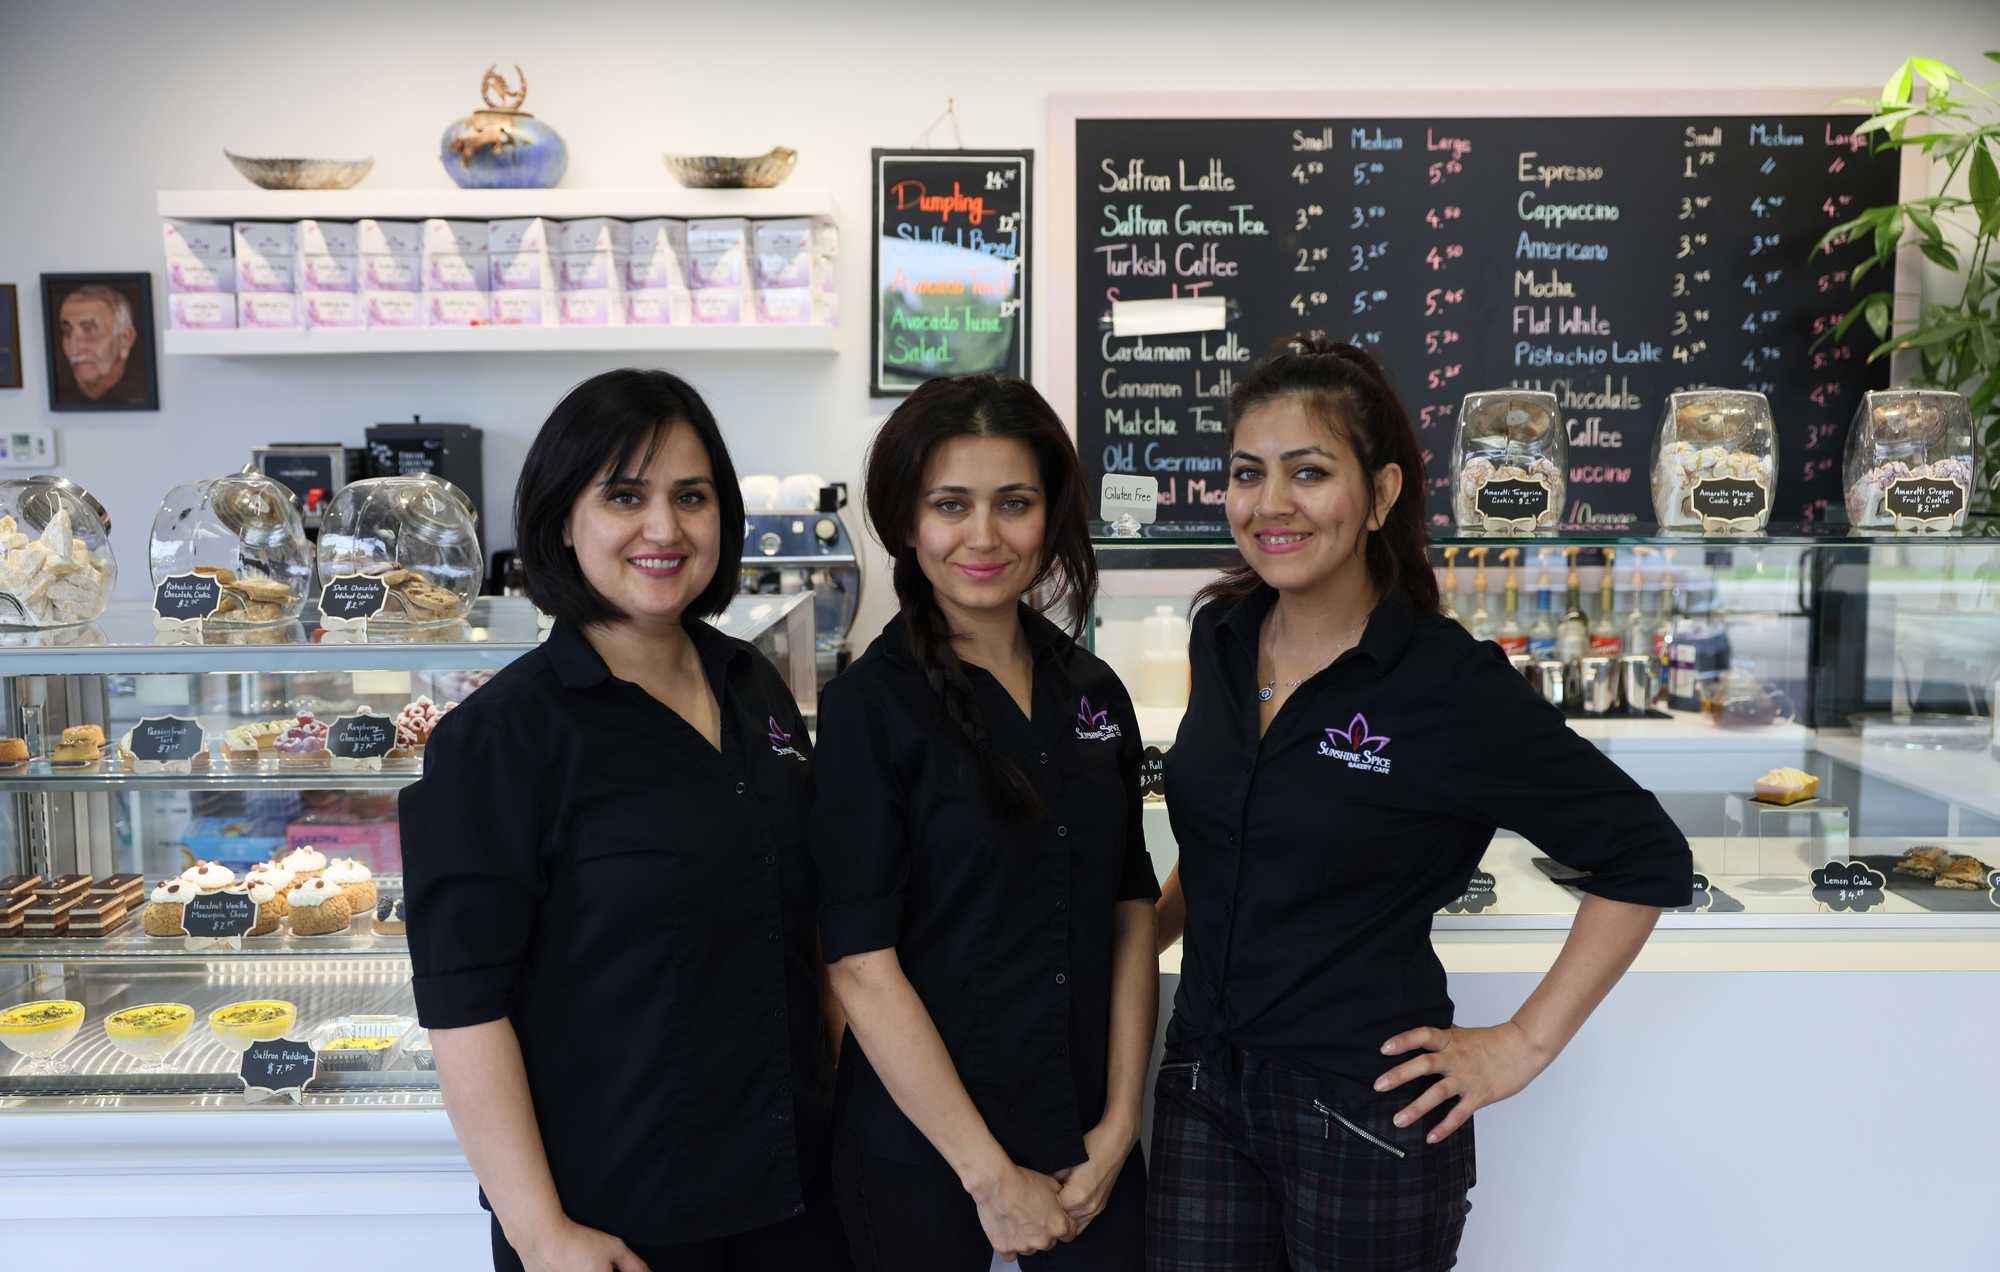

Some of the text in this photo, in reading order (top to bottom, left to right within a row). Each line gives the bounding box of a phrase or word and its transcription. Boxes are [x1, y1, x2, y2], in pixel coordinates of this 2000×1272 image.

[1293, 127, 1471, 159] Small Medium Large
[1684, 122, 1867, 152] Small Medium Large
[1099, 157, 1236, 193] Saffron Latte
[1518, 152, 1603, 189] Espresso
[890, 180, 996, 224] Dumpling
[1518, 191, 1620, 229] Cappuccino
[1101, 204, 1270, 237] Saffron Green Tea
[1094, 242, 1239, 276] Turkish Coffee
[1515, 230, 1608, 261] Americano
[1514, 268, 1576, 298] Mocha
[890, 307, 958, 332] Avocado
[1513, 305, 1610, 336] Flat White
[889, 336, 951, 364] Salad
[1102, 331, 1250, 362] Cardamom Latte
[1515, 341, 1663, 368] Pistachio Latte
[1101, 368, 1182, 398] Cinnamon
[1550, 375, 1642, 410] Chocolate
[1104, 405, 1226, 436] Matcha Tea
[1566, 416, 1623, 448] Coffee
[1103, 442, 1223, 472] Old German
[1570, 466, 1631, 483] uccino
[1104, 487, 1132, 501] Gluten
[1134, 488, 1151, 502] Free
[1512, 488, 1543, 498] Tangerine
[1902, 495, 1950, 504] Fruit Cookie
[1928, 487, 1954, 499] Dragon
[1149, 760, 1163, 770] Roll
[1317, 741, 1391, 768] SUNSHINE SPICE
[1347, 762, 1372, 771] BAKERY
[1823, 874, 1848, 885] Lemon
[252, 1049, 314, 1064] Saffron Pudding
